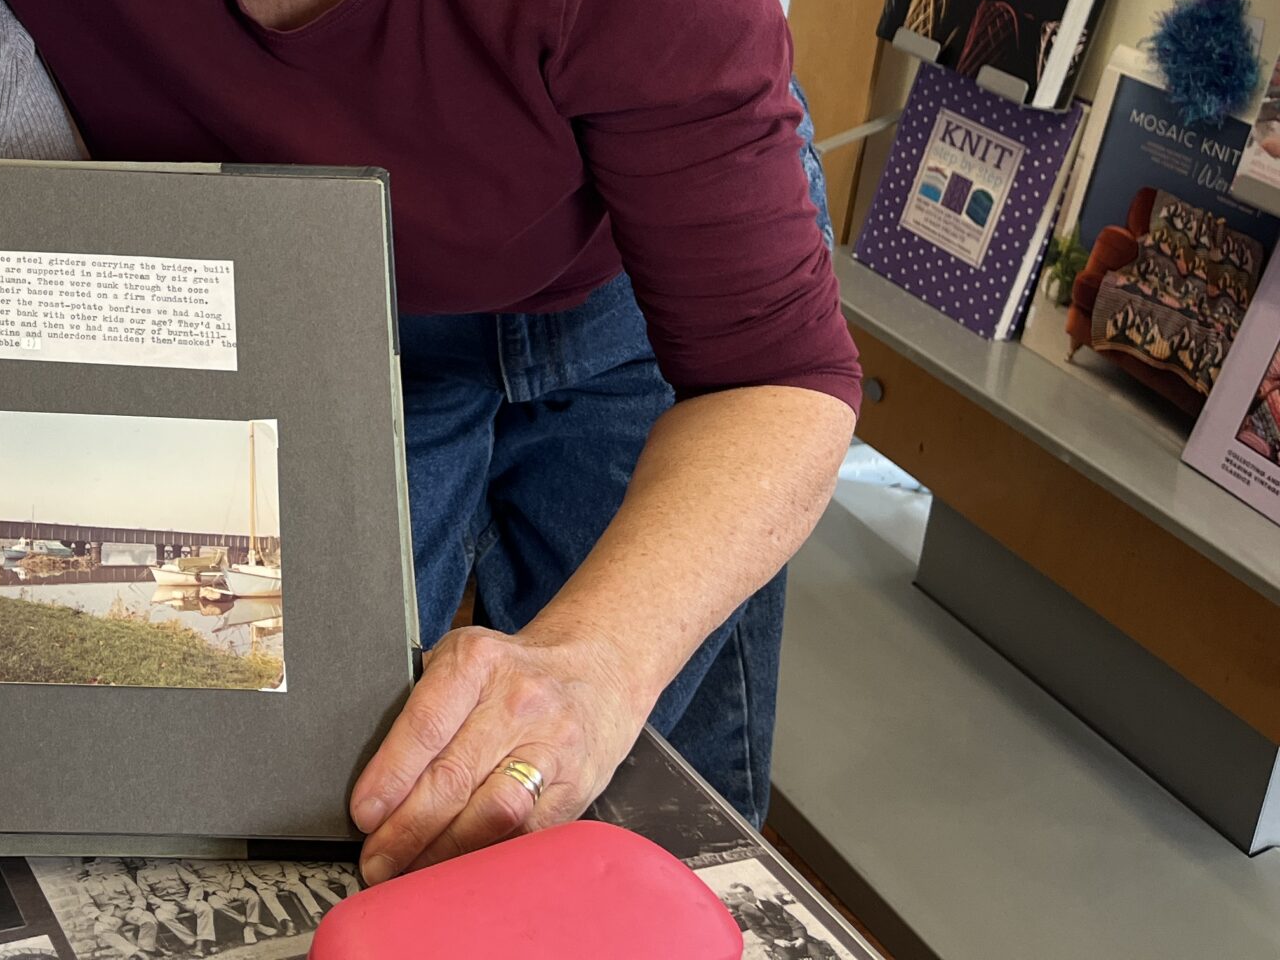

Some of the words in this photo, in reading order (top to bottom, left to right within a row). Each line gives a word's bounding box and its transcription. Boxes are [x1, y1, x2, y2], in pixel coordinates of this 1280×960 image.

[940, 121, 1013, 170] KNIT
[1130, 109, 1197, 148] MOSAIC
[1201, 138, 1242, 166] KNIT
[16, 256, 43, 265] steel
[48, 258, 86, 267] girders
[92, 261, 135, 270] carrying
[140, 262, 156, 270] the
[203, 264, 230, 274] built
[26, 267, 75, 276] supported
[96, 271, 150, 280] mid-stream
[156, 273, 166, 282] by
[193, 276, 219, 284] great
